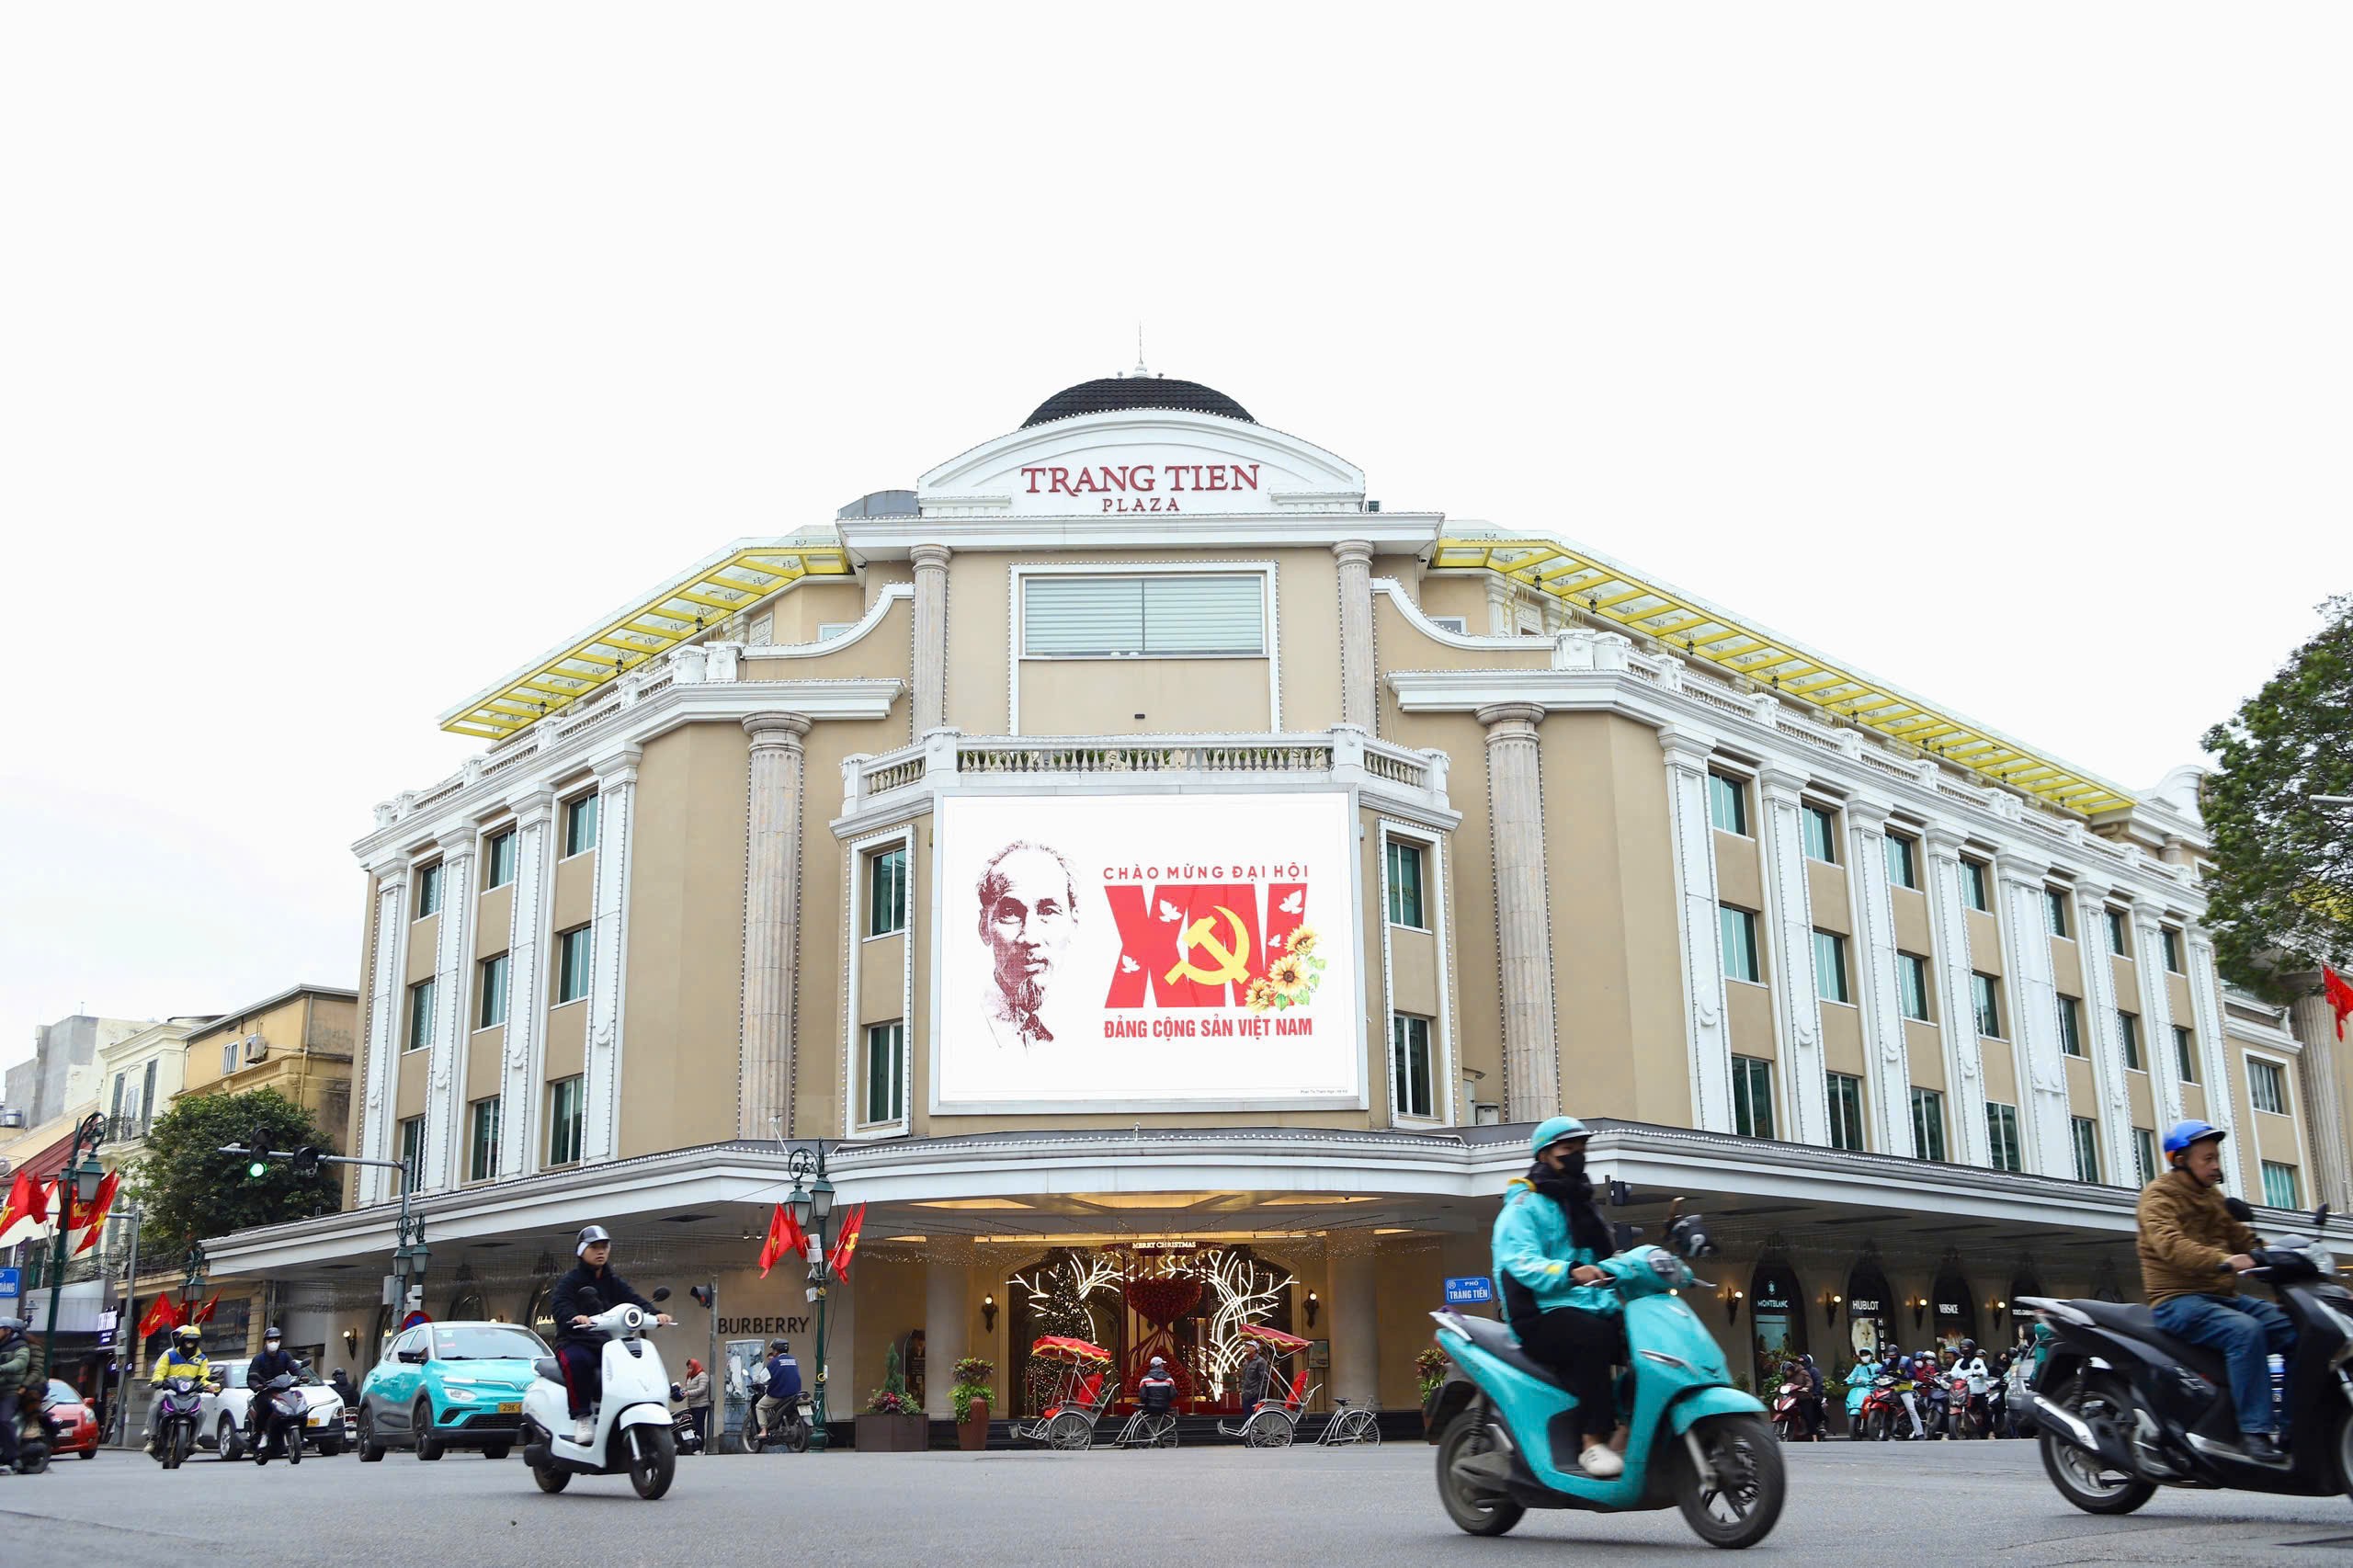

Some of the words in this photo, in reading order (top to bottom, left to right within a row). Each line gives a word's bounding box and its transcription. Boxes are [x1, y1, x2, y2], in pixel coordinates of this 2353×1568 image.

[1021, 466, 1154, 496] TRANG
[1165, 464, 1260, 491] TIEN
[1102, 497, 1180, 512] PLAZA
[1103, 864, 1159, 880] CHÀO
[1166, 863, 1224, 880] MỪNG
[1232, 865, 1266, 881] ĐẠI
[1273, 862, 1308, 881] HỘI
[1104, 883, 1308, 1008] XIV
[1104, 1015, 1148, 1039] ĐẢNG
[1153, 1016, 1196, 1040] CỘNG
[1200, 1013, 1233, 1038] SẢN
[1238, 1016, 1271, 1040] VIỆT
[1276, 1017, 1313, 1036] NAM
[1756, 1299, 1789, 1308] MONTBLANC
[1852, 1300, 1879, 1311] HUBLOT
[1938, 1303, 1959, 1314] VERSACE
[718, 1317, 809, 1334] BURBERRY
